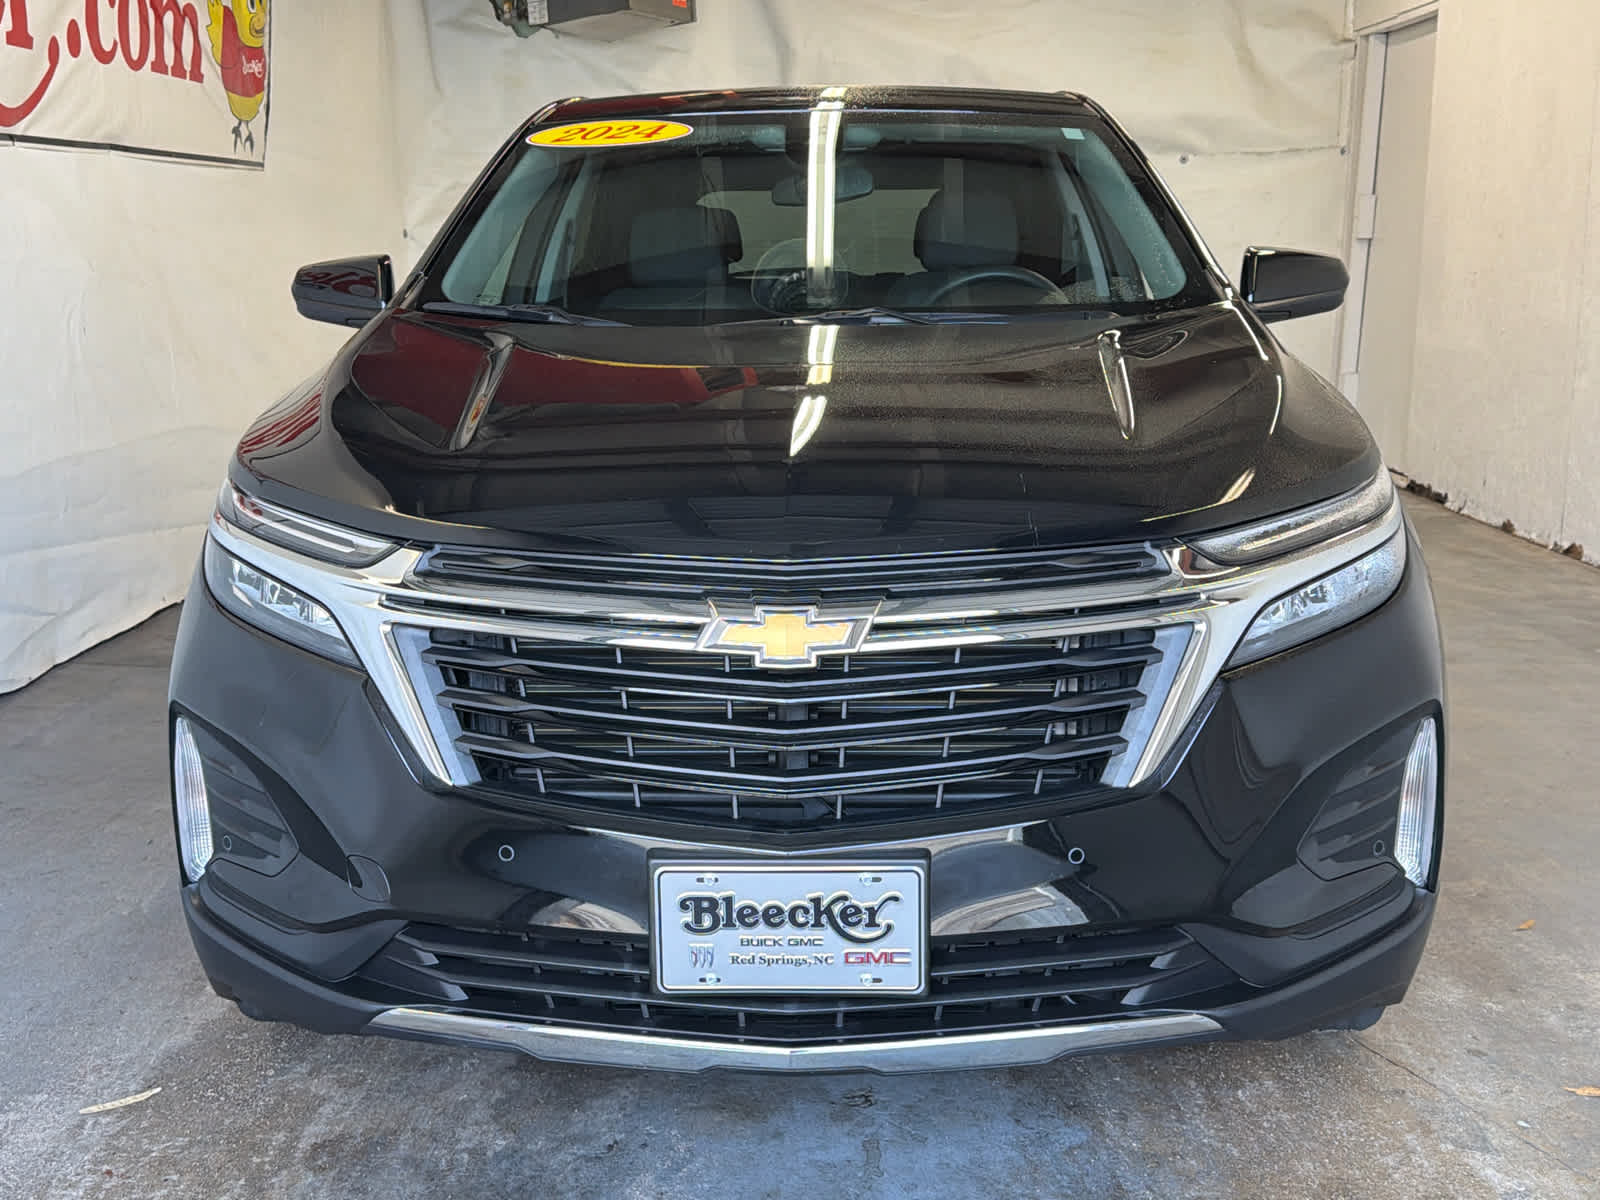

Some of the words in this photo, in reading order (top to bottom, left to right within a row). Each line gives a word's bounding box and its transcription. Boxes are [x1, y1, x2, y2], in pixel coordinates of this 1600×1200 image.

[553, 125, 668, 142] 2024
[739, 936, 783, 947] BUICK
[786, 936, 824, 947] GMC
[729, 953, 756, 965] Red
[844, 951, 912, 965] GMC
